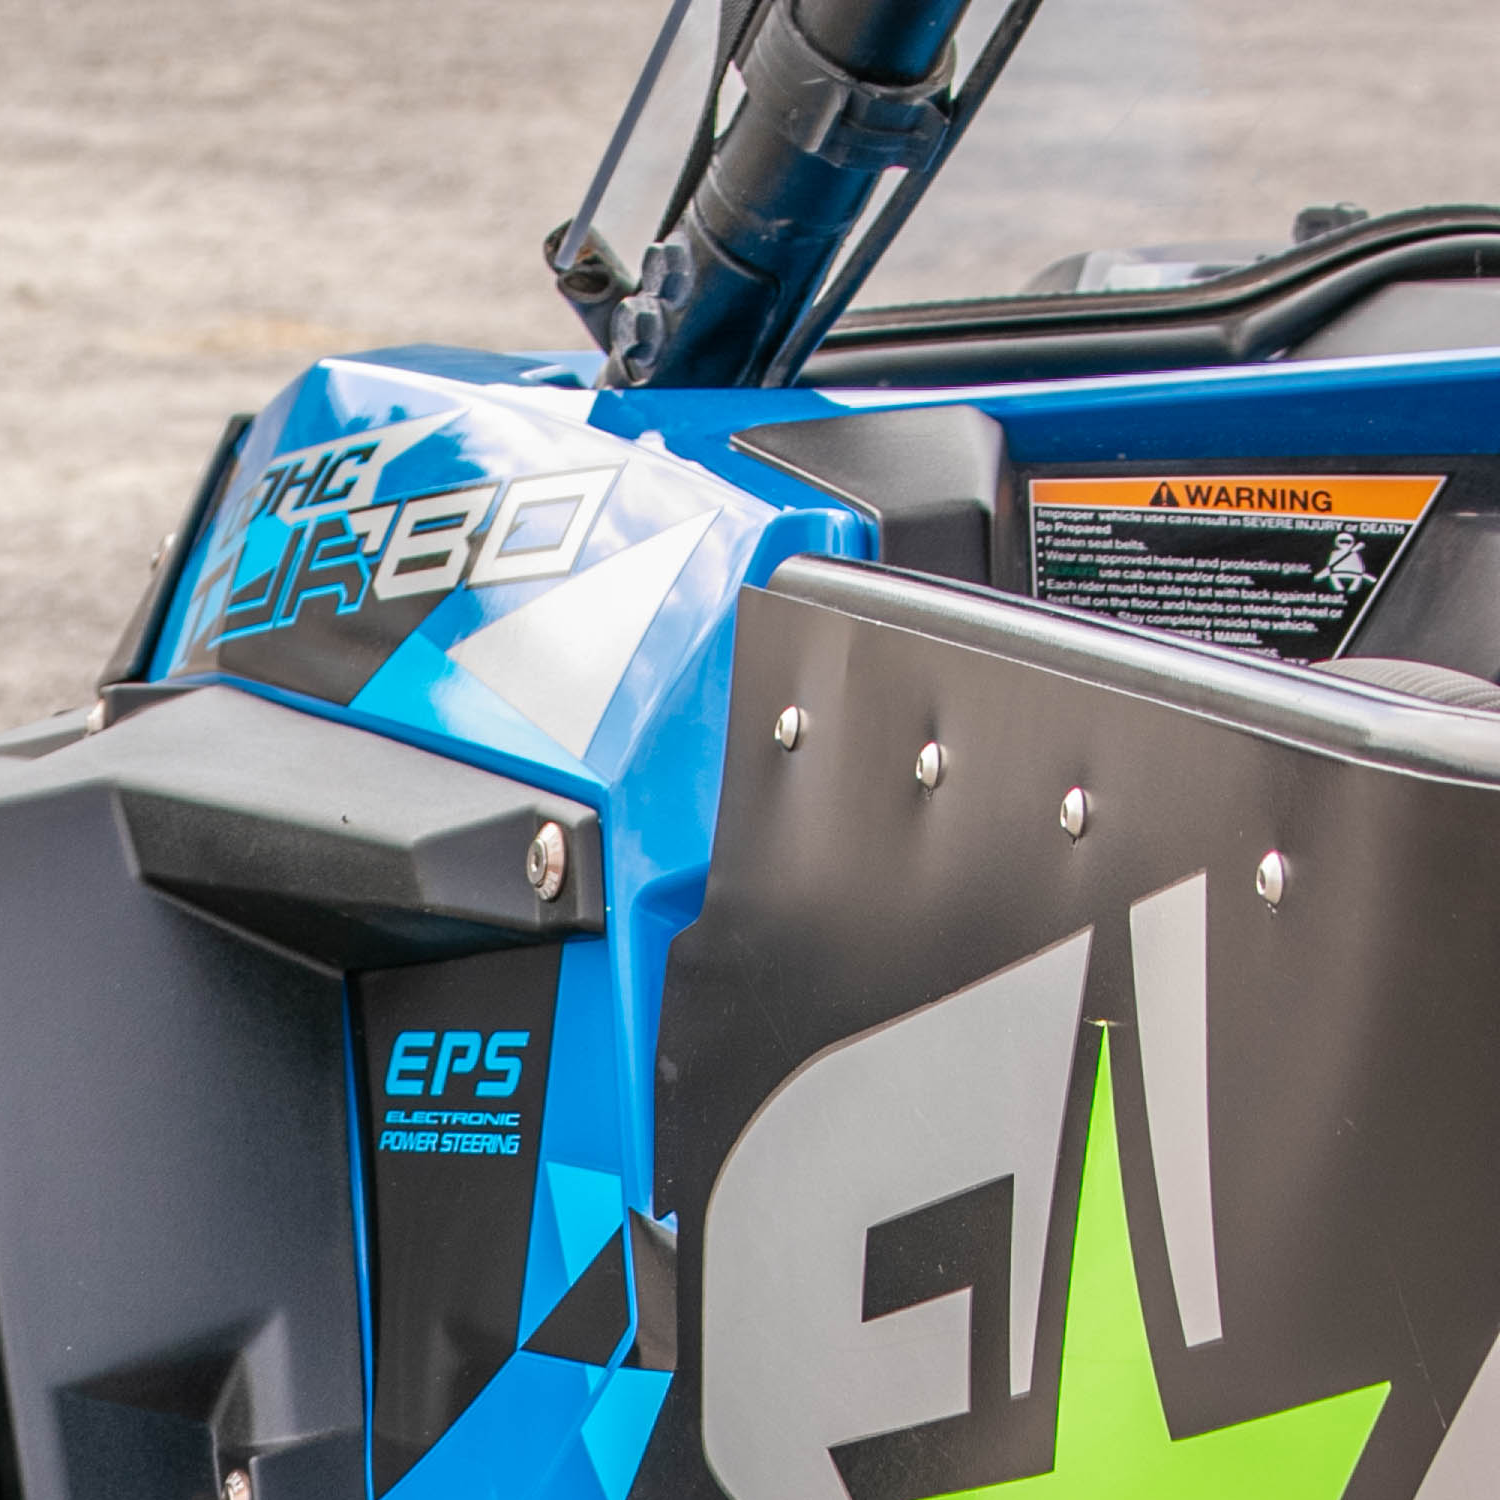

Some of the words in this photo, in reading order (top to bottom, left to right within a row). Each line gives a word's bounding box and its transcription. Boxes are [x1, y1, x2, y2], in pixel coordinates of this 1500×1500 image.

[1185, 484, 1333, 512] WARNING
[1036, 520, 1052, 531] Be
[1054, 522, 1112, 534] Prepared
[1038, 509, 1094, 521] Improper
[1098, 511, 1142, 522] vehicle
[1144, 514, 1166, 523] use
[1168, 515, 1191, 523] can
[1192, 515, 1228, 525] result
[1229, 516, 1241, 526] in
[1243, 517, 1293, 529] SEVERE
[1295, 519, 1343, 531] INJURY
[1345, 523, 1358, 532] or
[1360, 523, 1405, 534] DEATH
[1045, 536, 1086, 547] Fasten
[1088, 538, 1113, 549] seat
[1046, 551, 1076, 561] Wear
[1095, 554, 1151, 565] approved
[1153, 555, 1194, 566] helmet
[1196, 557, 1219, 567] and
[1221, 560, 1280, 572] protective
[1099, 569, 1121, 578] use
[1122, 569, 1145, 580] cab
[1147, 571, 1173, 581] nets
[1047, 579, 1076, 591] Each
[1078, 581, 1106, 592] rider
[1107, 583, 1137, 593] must
[1139, 584, 1155, 594] be
[1156, 585, 1182, 595] able
[1184, 587, 1197, 596] to
[1214, 588, 1240, 598] with
[1241, 589, 1270, 599] back
[1093, 598, 1108, 606] on
[1110, 597, 1130, 607] the
[1163, 600, 1185, 610] and
[1187, 601, 1223, 612] hands
[1225, 604, 1241, 613] on
[1117, 611, 1145, 625] Stay
[1146, 613, 1212, 628] completely
[1213, 618, 1249, 629] inside
[1251, 619, 1270, 629] the
[384, 1031, 531, 1097] EPS
[385, 1111, 521, 1126] ELECTRONIC
[379, 1131, 438, 1152] POWER
[440, 1132, 521, 1155] STEERING
